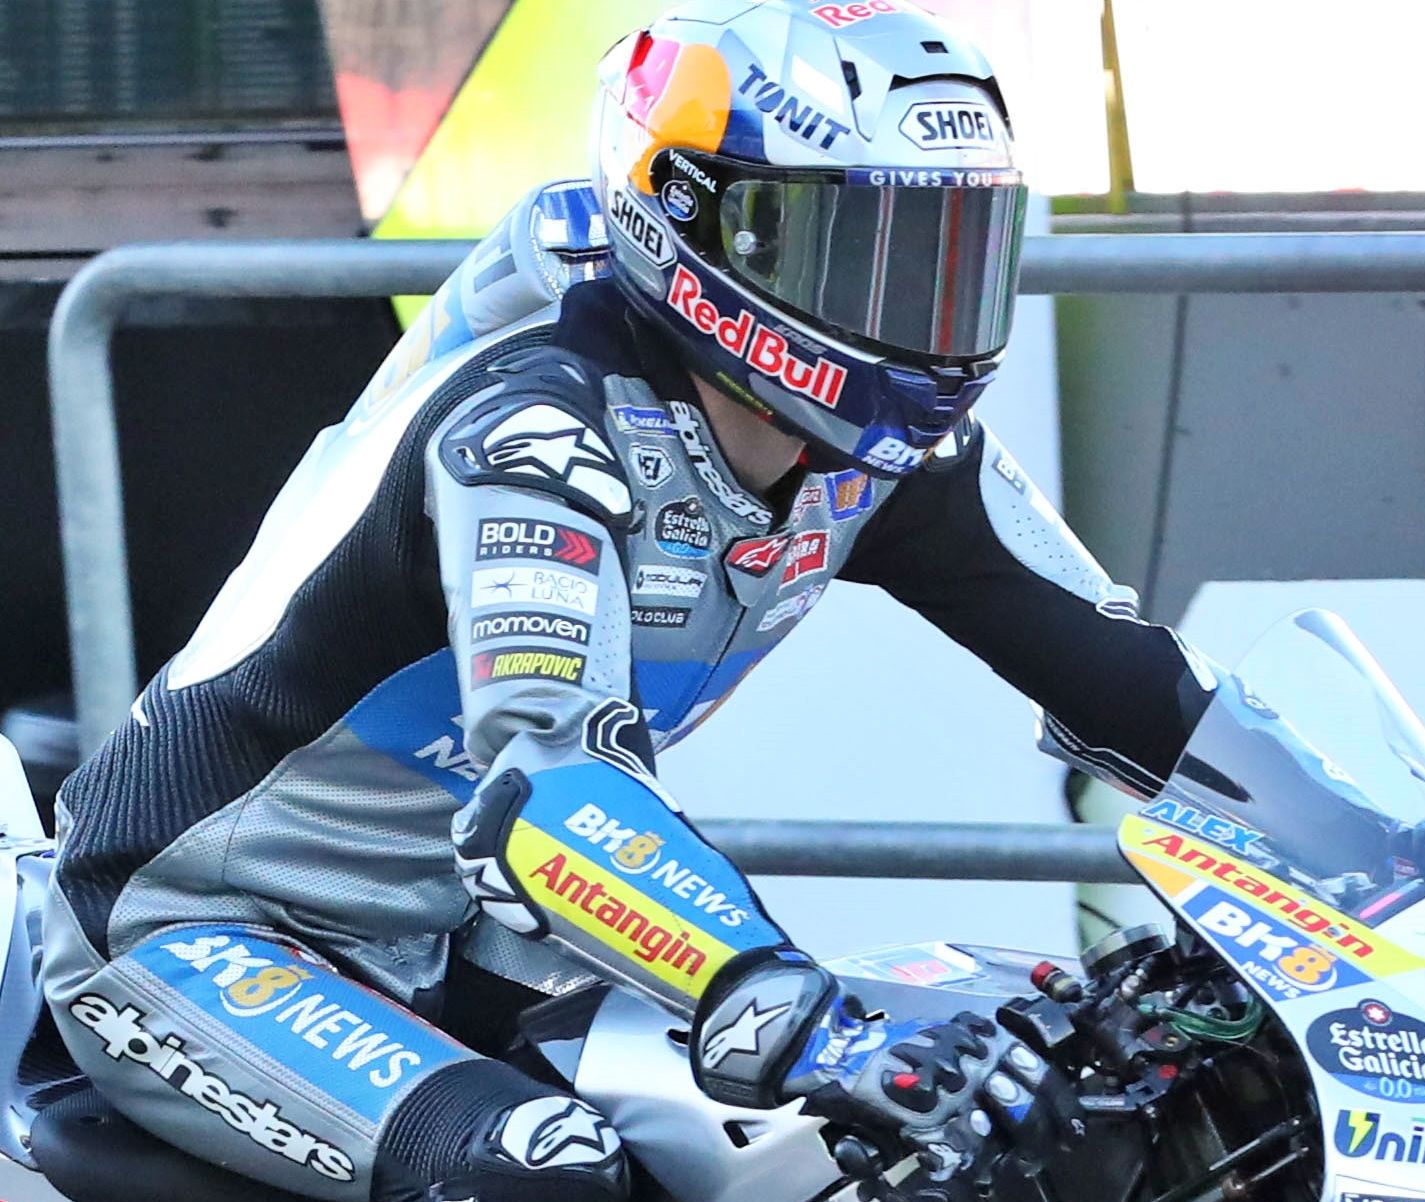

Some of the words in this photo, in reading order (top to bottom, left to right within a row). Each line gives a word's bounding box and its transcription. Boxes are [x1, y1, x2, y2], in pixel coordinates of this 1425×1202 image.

[737, 62, 852, 151] TONIT
[916, 103, 995, 144] SHOEI
[869, 170, 942, 186] GIVES
[951, 171, 993, 187] YOU
[610, 192, 665, 261] SHOEI
[668, 264, 750, 359] Red
[747, 324, 847, 407] Bull
[479, 545, 553, 557] RIDERS
[481, 522, 556, 545] BOLD
[473, 617, 588, 642] momoven
[1139, 798, 1265, 854] ALEX
[562, 802, 667, 872] BK8
[650, 858, 750, 930] NEWS
[1142, 833, 1375, 959] Antangin
[528, 852, 708, 978] Antangin
[1197, 899, 1337, 986] BK8
[1241, 958, 1301, 1000] NEWS
[273, 994, 422, 1089] NEWS
[71, 993, 355, 1183] alpinestars
